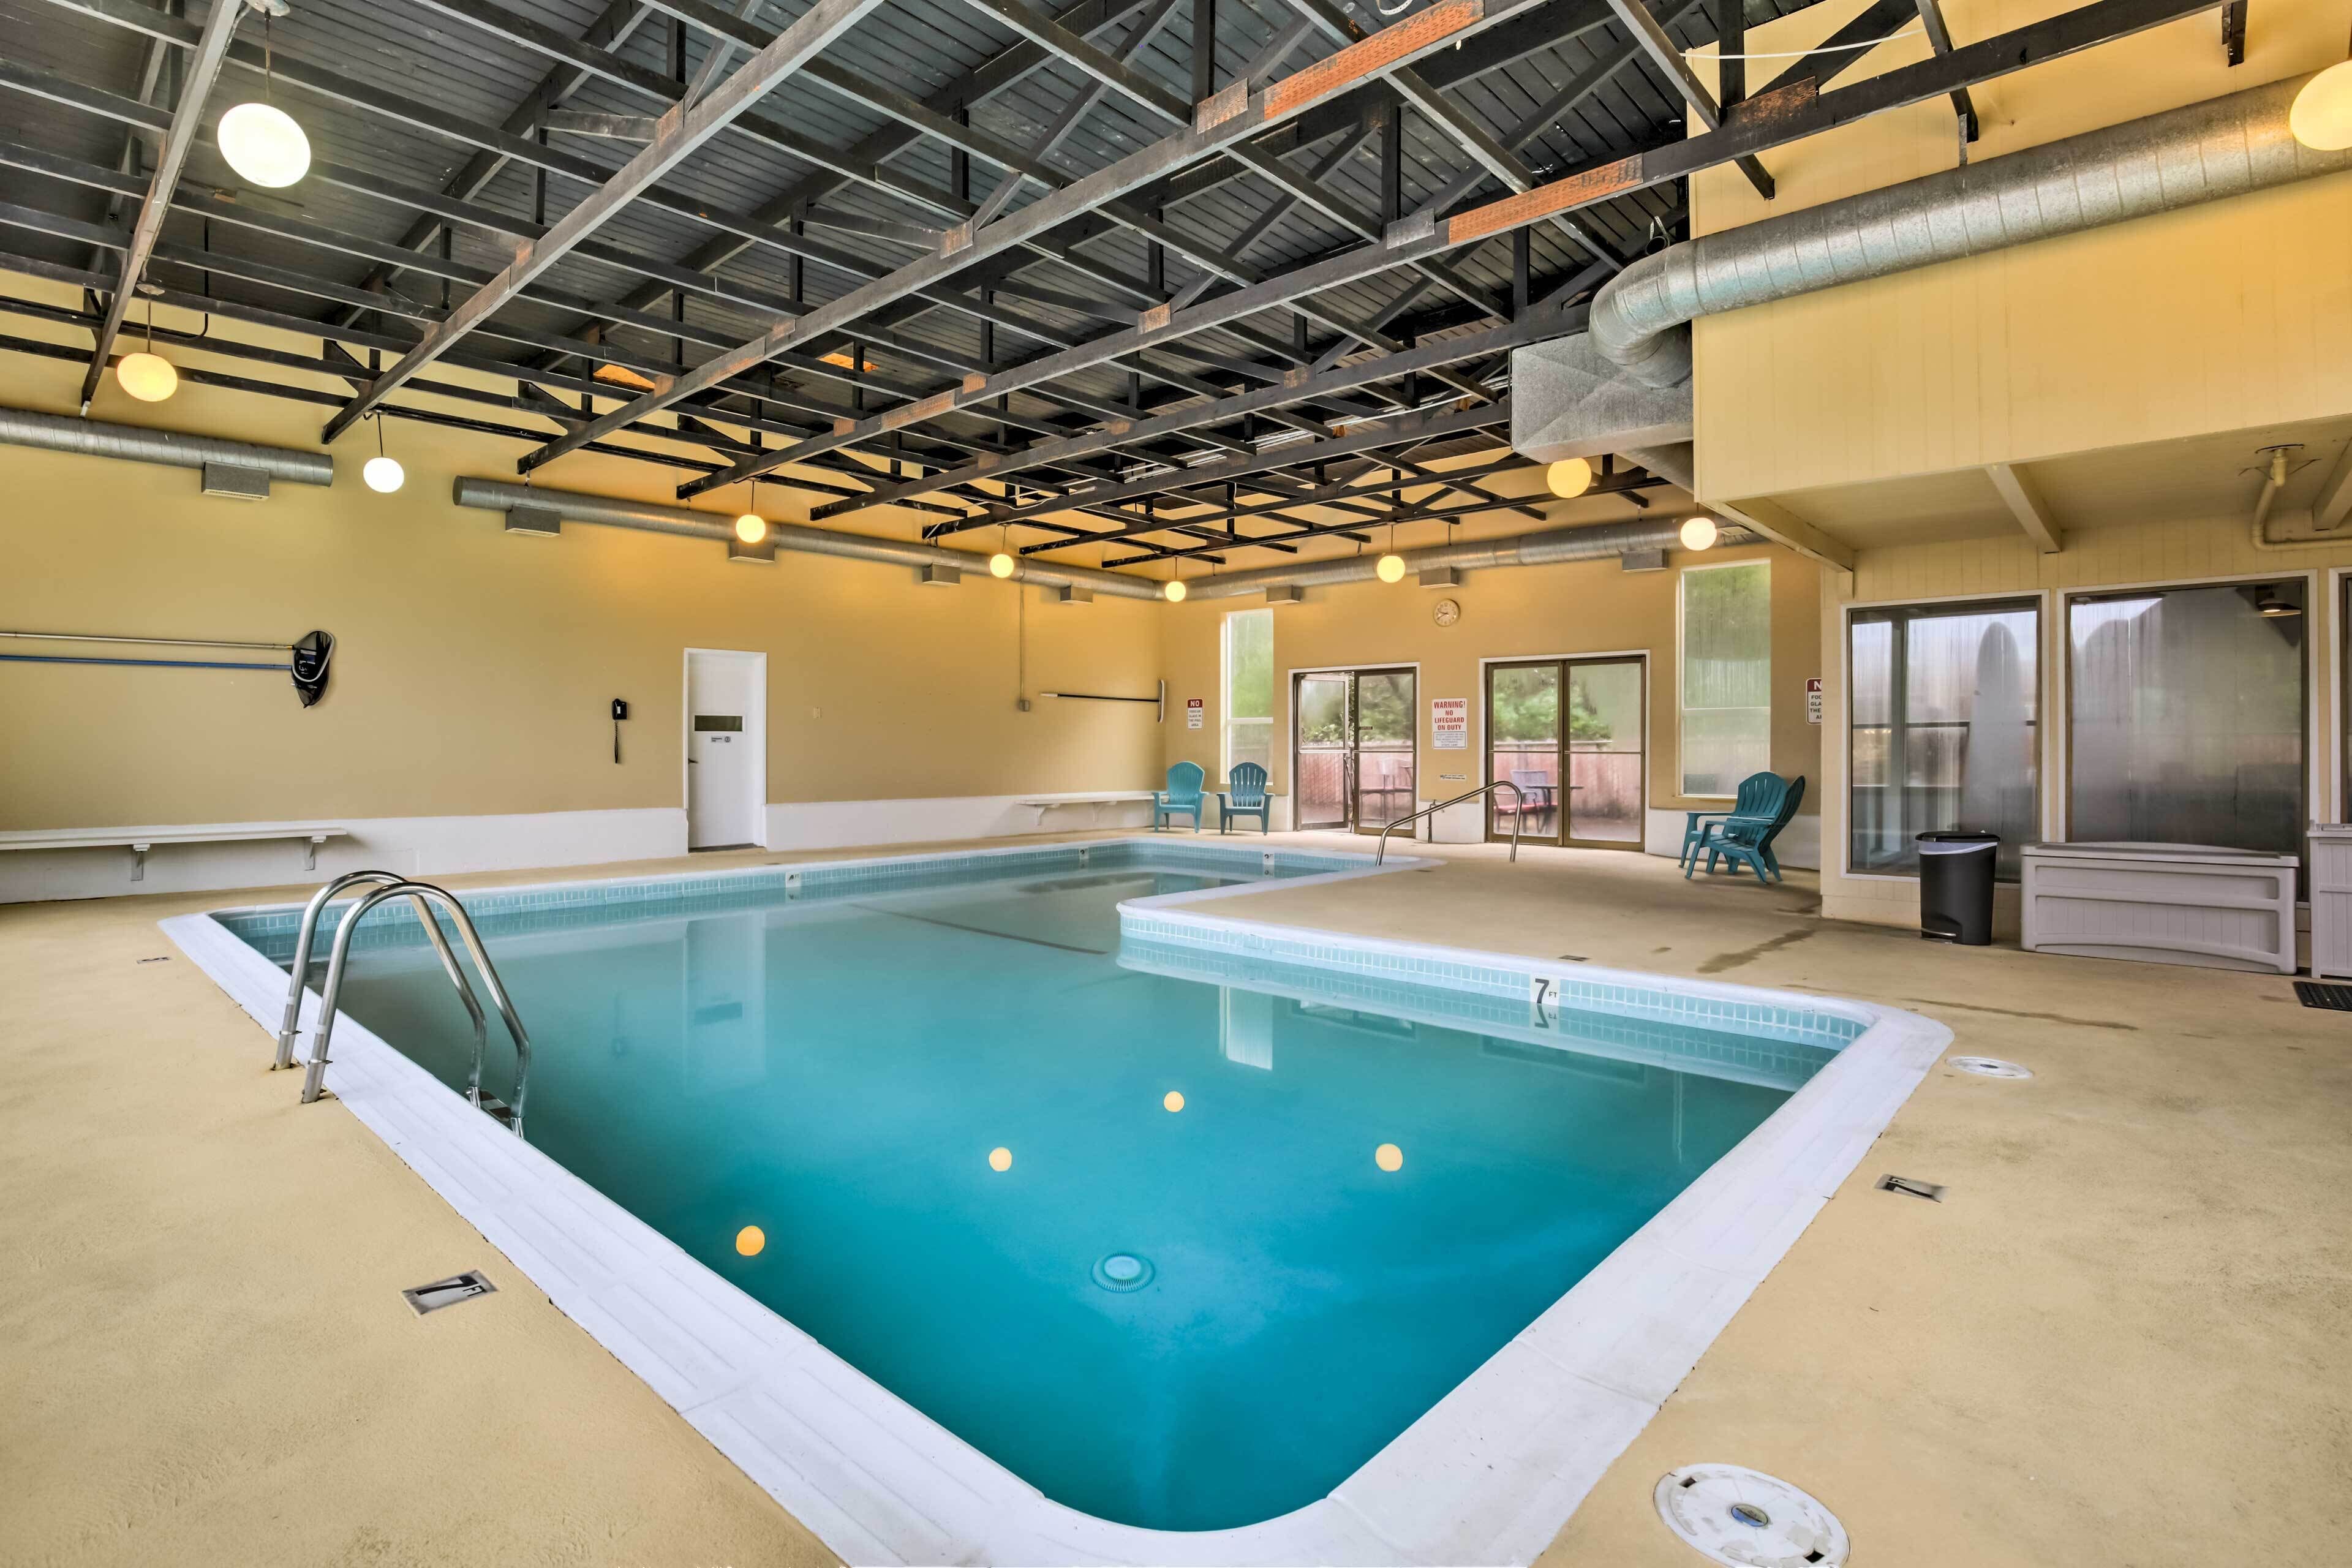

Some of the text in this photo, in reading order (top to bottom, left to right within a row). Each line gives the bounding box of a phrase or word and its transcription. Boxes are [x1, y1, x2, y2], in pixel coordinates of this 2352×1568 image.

[1814, 680, 1822, 690] N
[1535, 978, 1550, 1005] 7
[1882, 1181, 1934, 1199] 7
[415, 1275, 488, 1298] 7 FT
